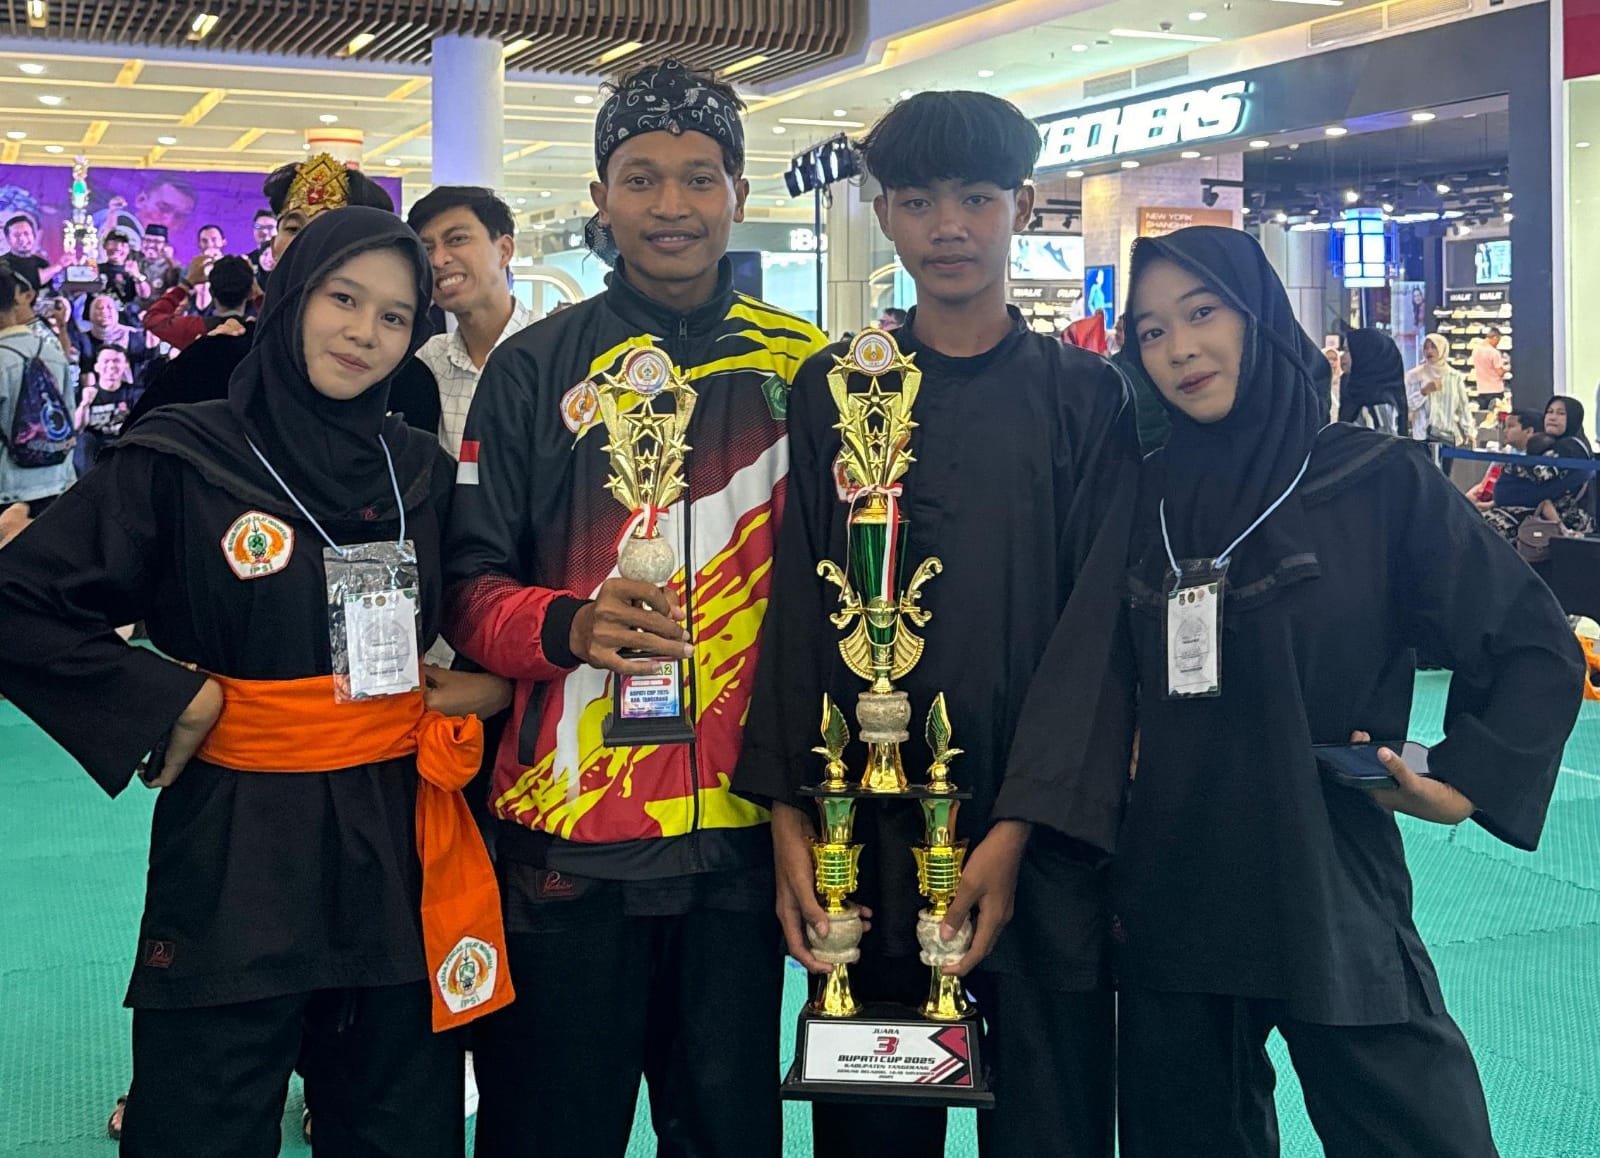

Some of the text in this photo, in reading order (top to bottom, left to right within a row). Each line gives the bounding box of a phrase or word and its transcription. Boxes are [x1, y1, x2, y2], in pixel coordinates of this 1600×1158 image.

[1145, 212, 1166, 220] NEW
[664, 663, 673, 675] 2
[873, 1036, 899, 1055] 3
[838, 1055, 877, 1063] BUPATI
[904, 1056, 936, 1065] 2025
